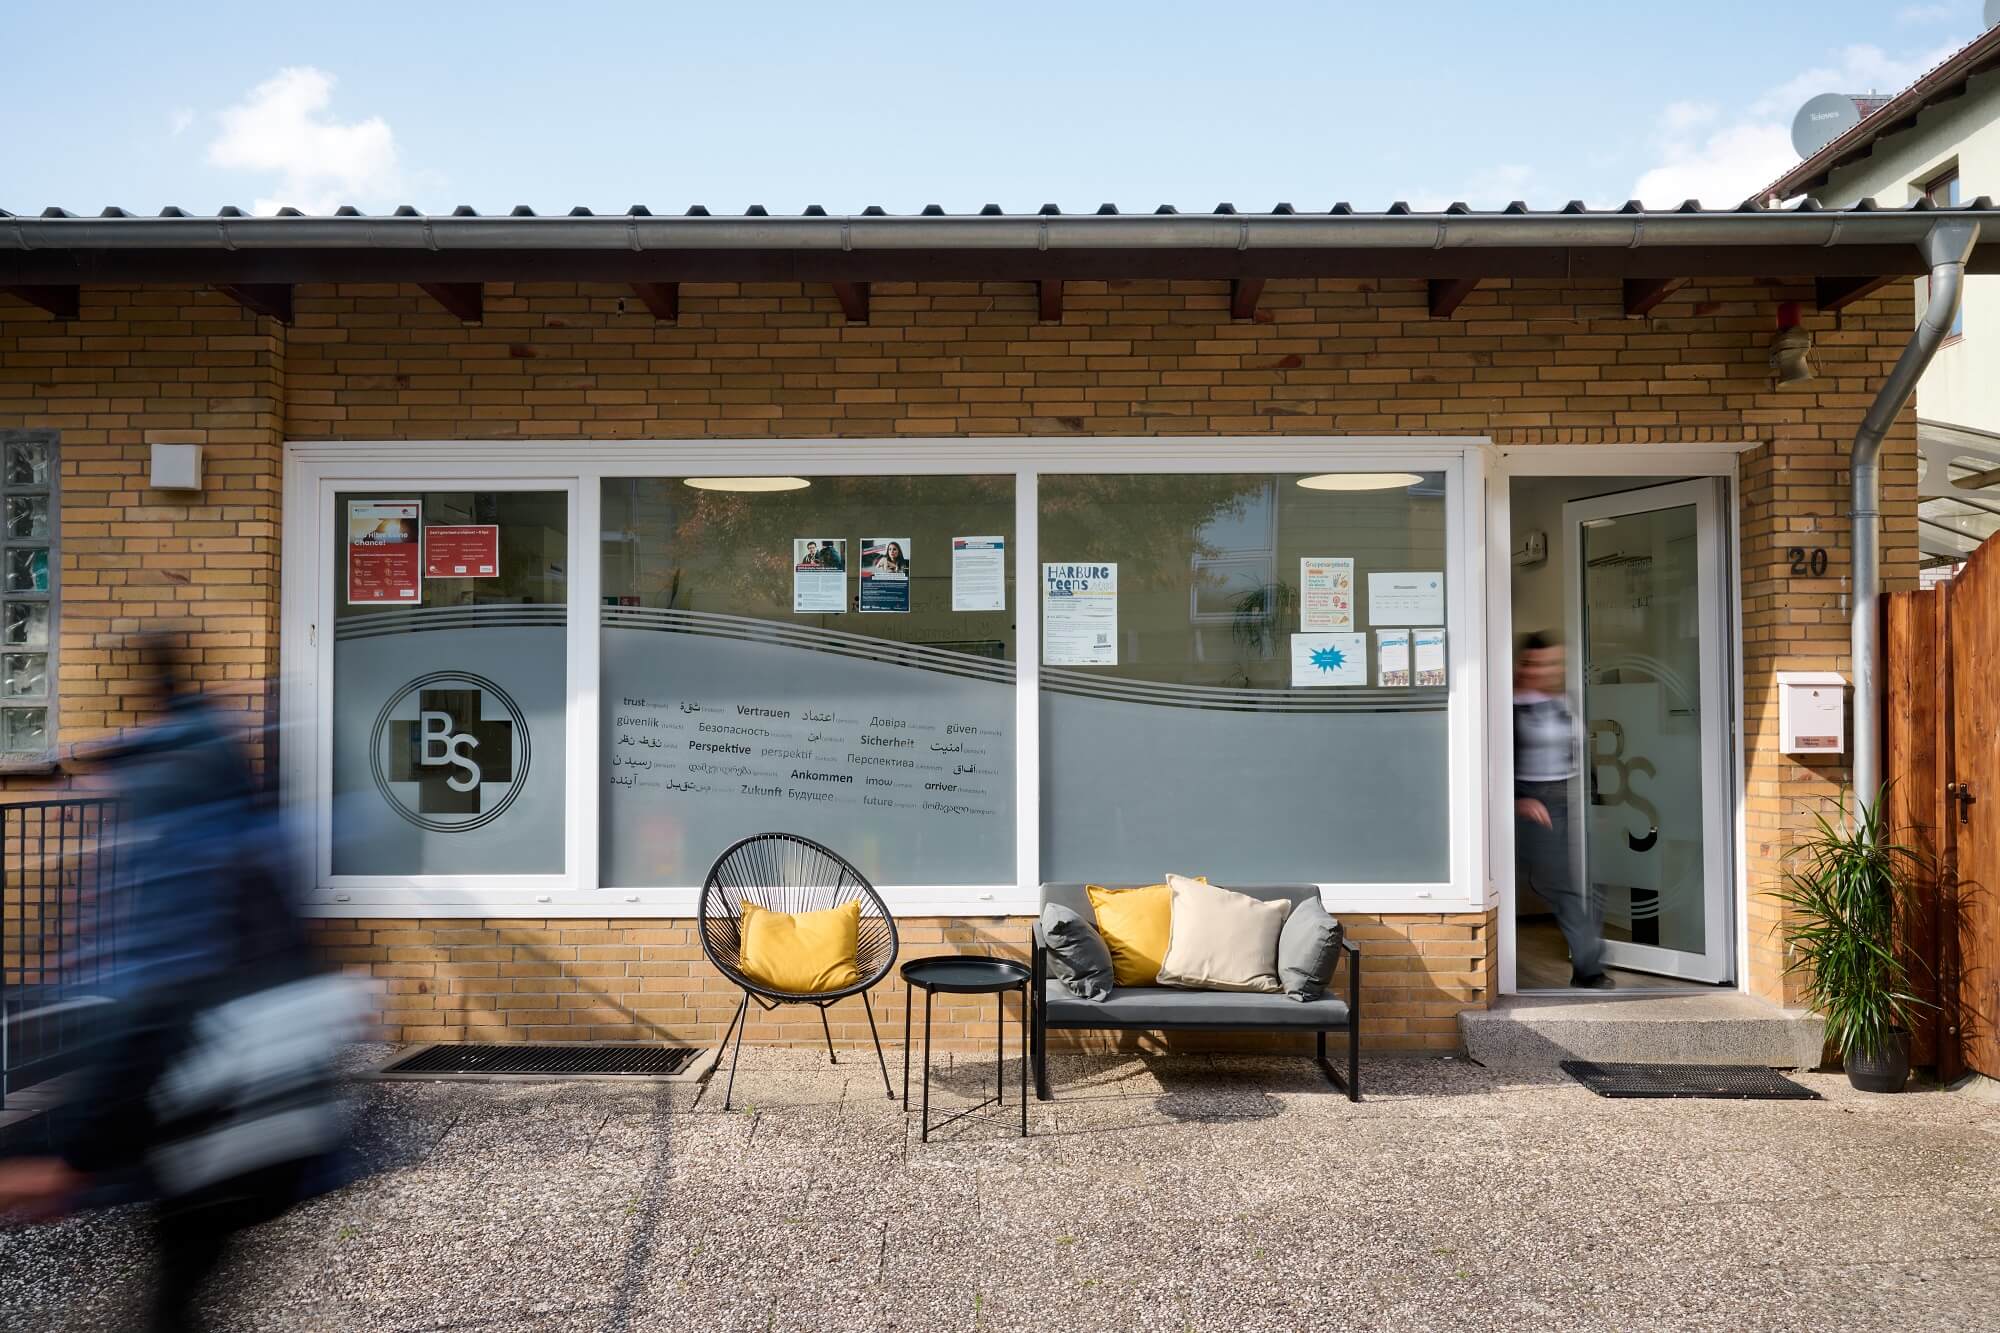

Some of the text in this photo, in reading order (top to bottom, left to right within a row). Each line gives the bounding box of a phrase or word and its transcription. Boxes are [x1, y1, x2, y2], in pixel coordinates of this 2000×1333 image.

[354, 538, 386, 547] Chance!
[1790, 547, 1828, 577] 20
[1048, 566, 1109, 579] HARBURG
[1047, 578, 1088, 591] Teens
[624, 697, 646, 706] trust
[737, 705, 790, 718] Vertrauen
[617, 715, 660, 728] güvenlik
[870, 716, 907, 729] Довіра
[699, 722, 770, 737] Безопасность
[946, 723, 978, 735] güven
[689, 740, 752, 755] Perspektive
[861, 735, 915, 748] Sicherheit
[421, 711, 480, 792] BS
[761, 748, 813, 761] perspektif
[847, 754, 914, 769] Перспектива
[791, 769, 853, 784] Ankommen
[741, 785, 782, 798] Zukunft
[925, 782, 958, 793] arriver
[788, 788, 834, 802] Будущее
[863, 795, 893, 807] future
